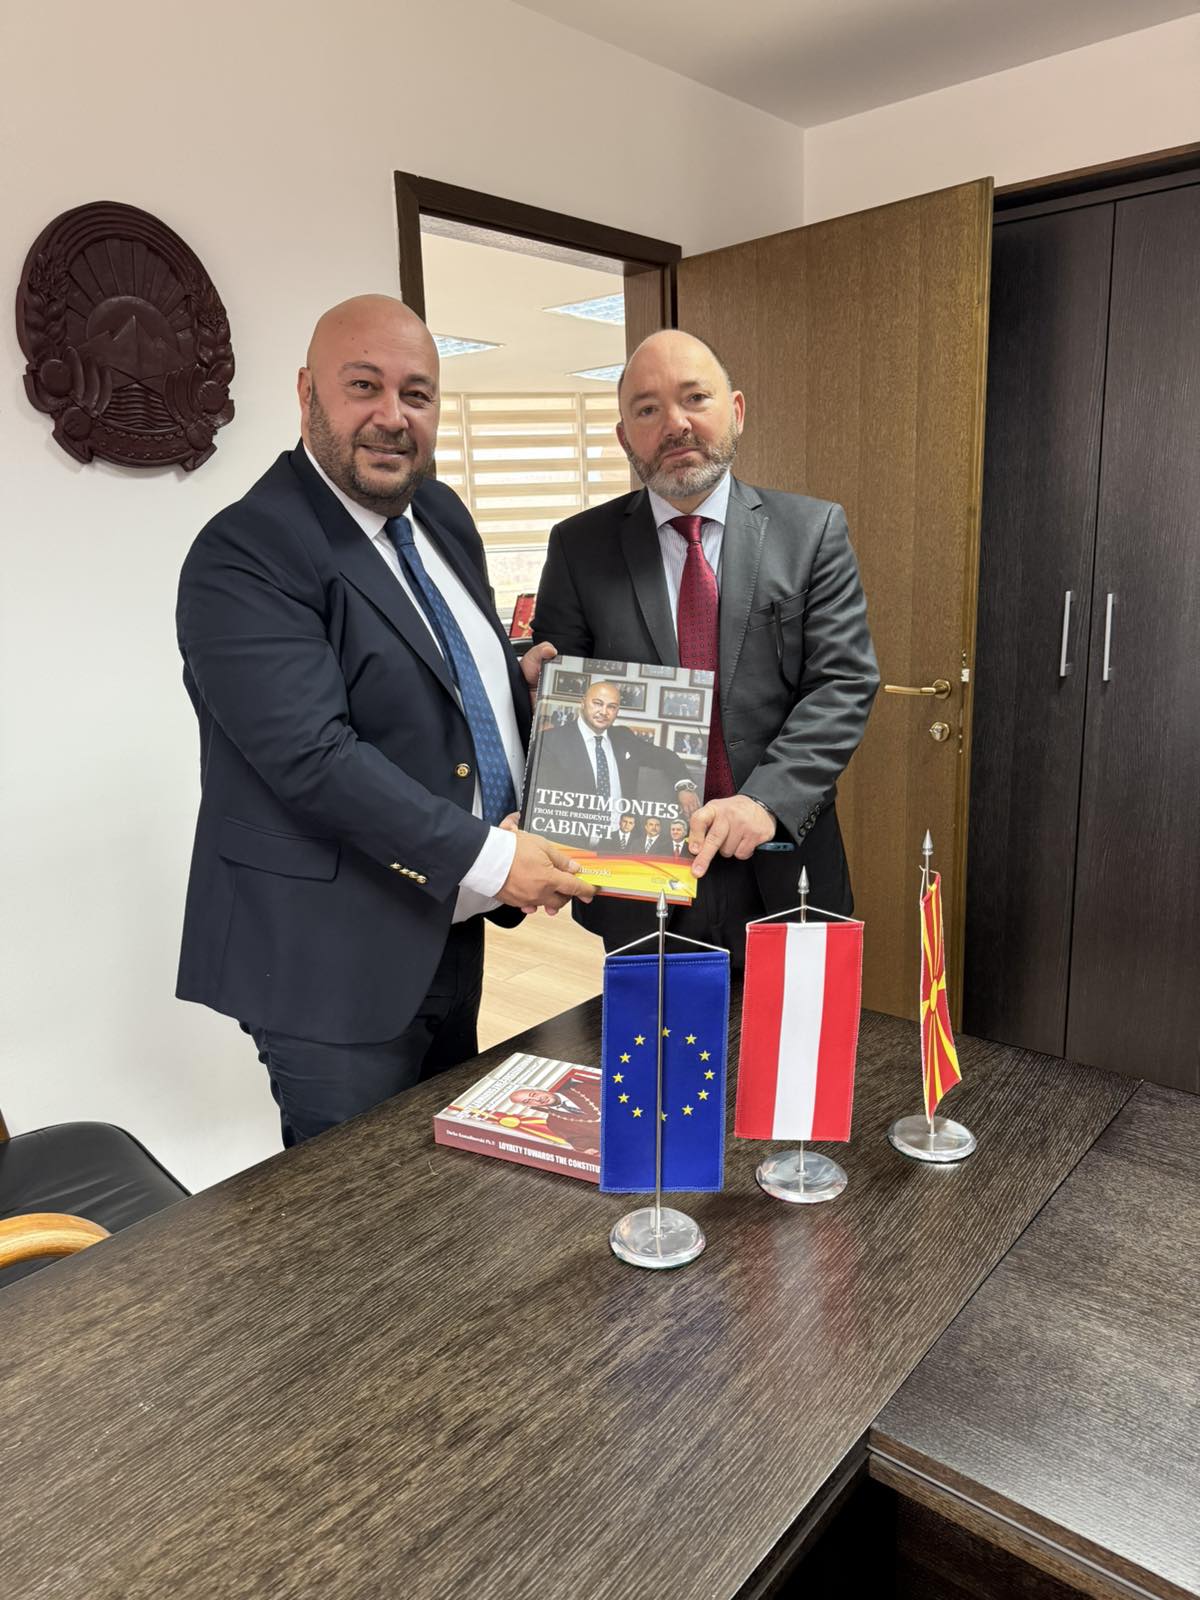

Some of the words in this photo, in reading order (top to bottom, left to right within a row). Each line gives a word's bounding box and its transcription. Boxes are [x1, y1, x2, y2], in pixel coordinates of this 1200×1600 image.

[533, 807, 554, 816] FROM
[554, 809, 569, 818] THE
[536, 788, 679, 819] TESTIMONIES
[531, 817, 614, 840] CABINET
[498, 1141, 523, 1155] LOYALTY
[523, 1146, 554, 1163] TOWARDS
[555, 1154, 568, 1166] THE
